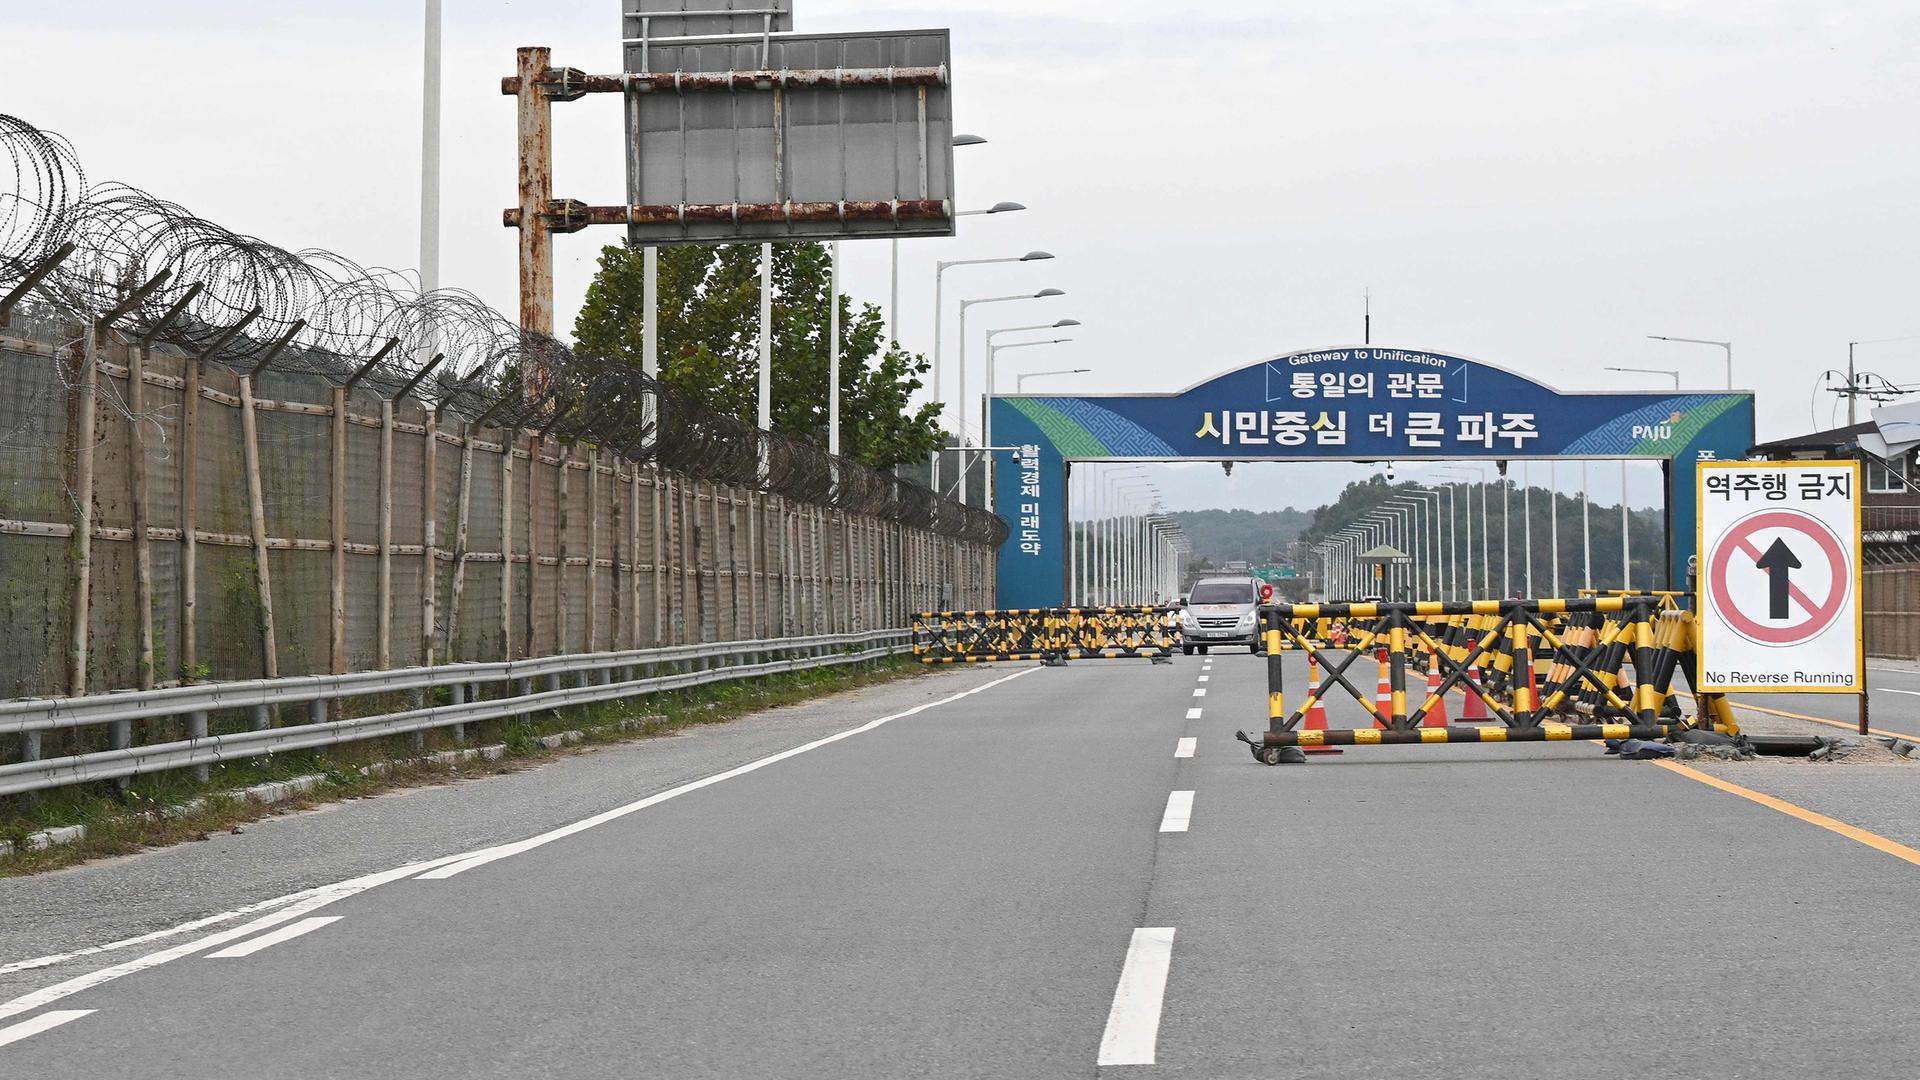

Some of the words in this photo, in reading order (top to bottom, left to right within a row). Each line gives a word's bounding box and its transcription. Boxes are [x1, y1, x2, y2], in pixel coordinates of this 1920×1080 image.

[1289, 350, 1350, 366] Gateway
[1354, 349, 1368, 360] to
[1373, 349, 1447, 368] Unification
[1290, 373, 1374, 398] 통일의
[1387, 373, 1444, 398] 관문
[1195, 411, 1346, 445] 시민중심
[1369, 412, 1393, 437] 더
[1404, 412, 1445, 447] 큰
[1457, 412, 1539, 448] 파주
[1632, 425, 1672, 441] PAJU
[1020, 444, 1040, 498] 활력경제
[1706, 473, 1787, 501] 역주행
[1798, 472, 1851, 500] 금지
[1020, 503, 1040, 556] 미래도약
[1705, 672, 1726, 683] No
[1731, 672, 1789, 683] Reverse
[1794, 672, 1853, 686] Running
